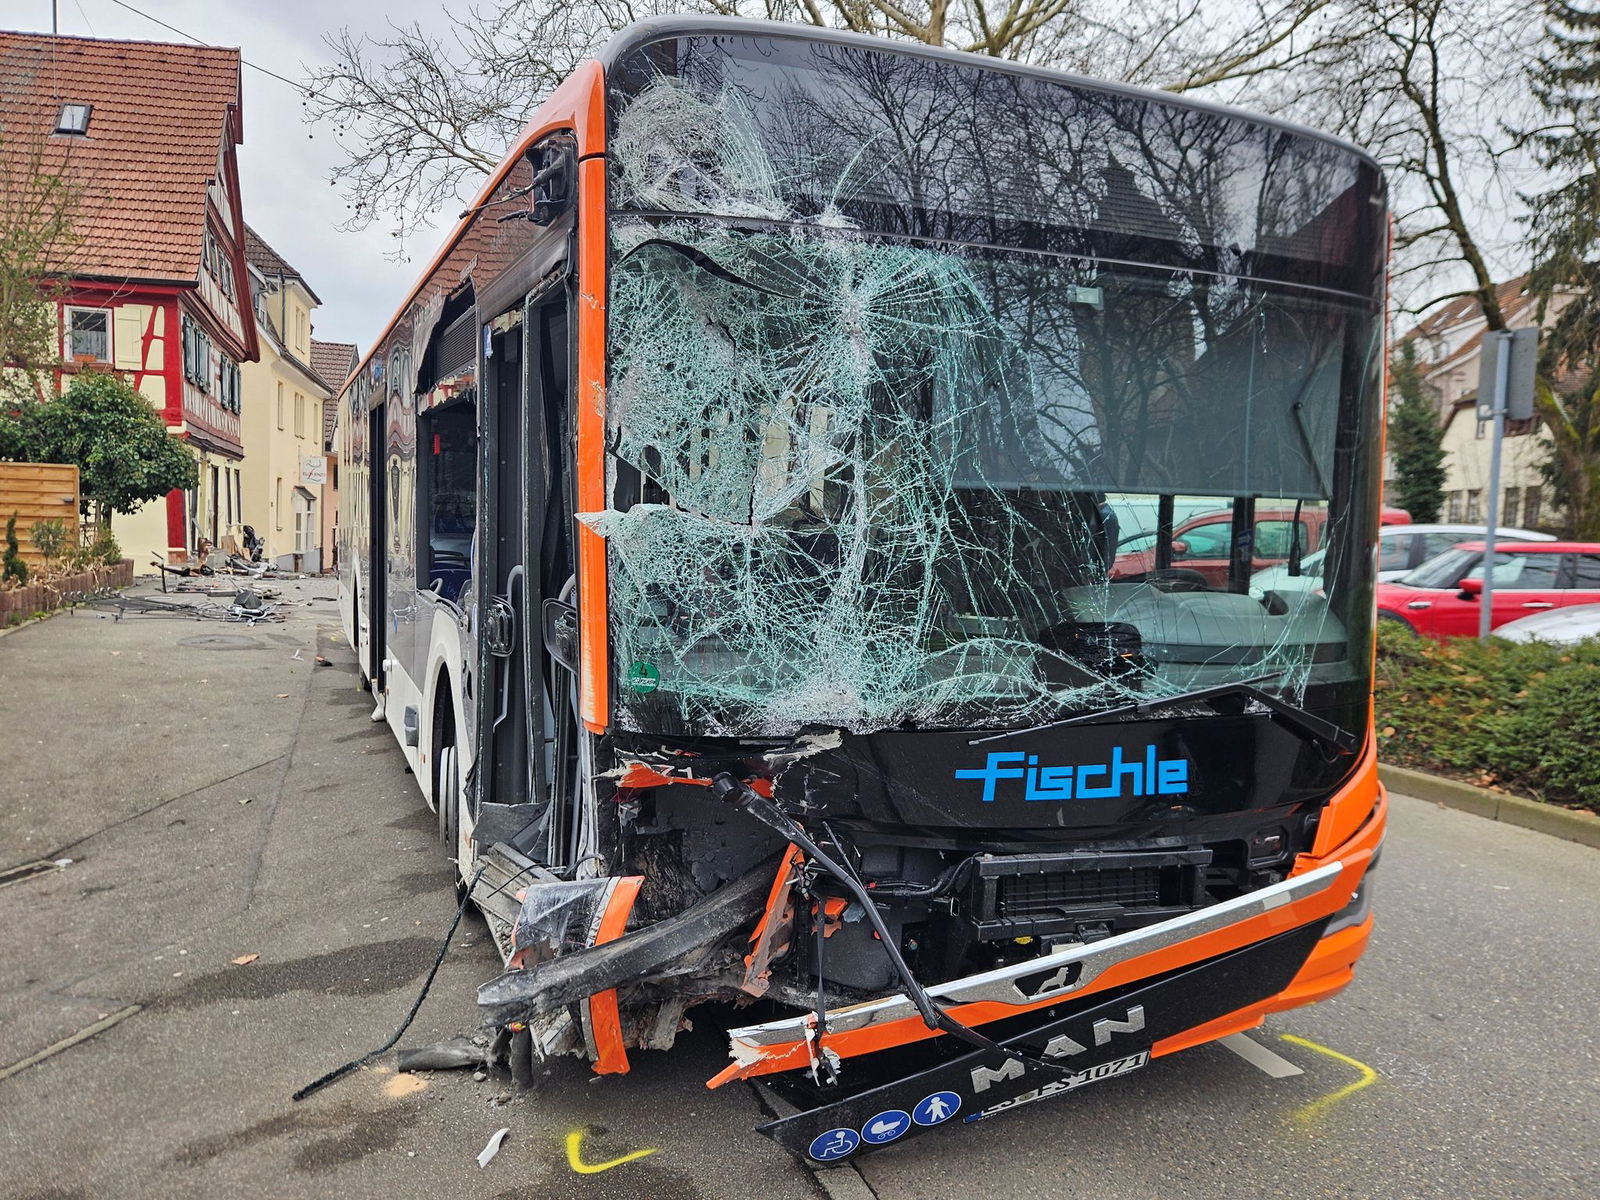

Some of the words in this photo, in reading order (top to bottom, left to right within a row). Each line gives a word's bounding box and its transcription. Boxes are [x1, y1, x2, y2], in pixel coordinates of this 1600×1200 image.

[955, 745, 1189, 801] Fischle
[970, 1004, 1145, 1093] MAN
[1078, 1056, 1143, 1083] 1071
